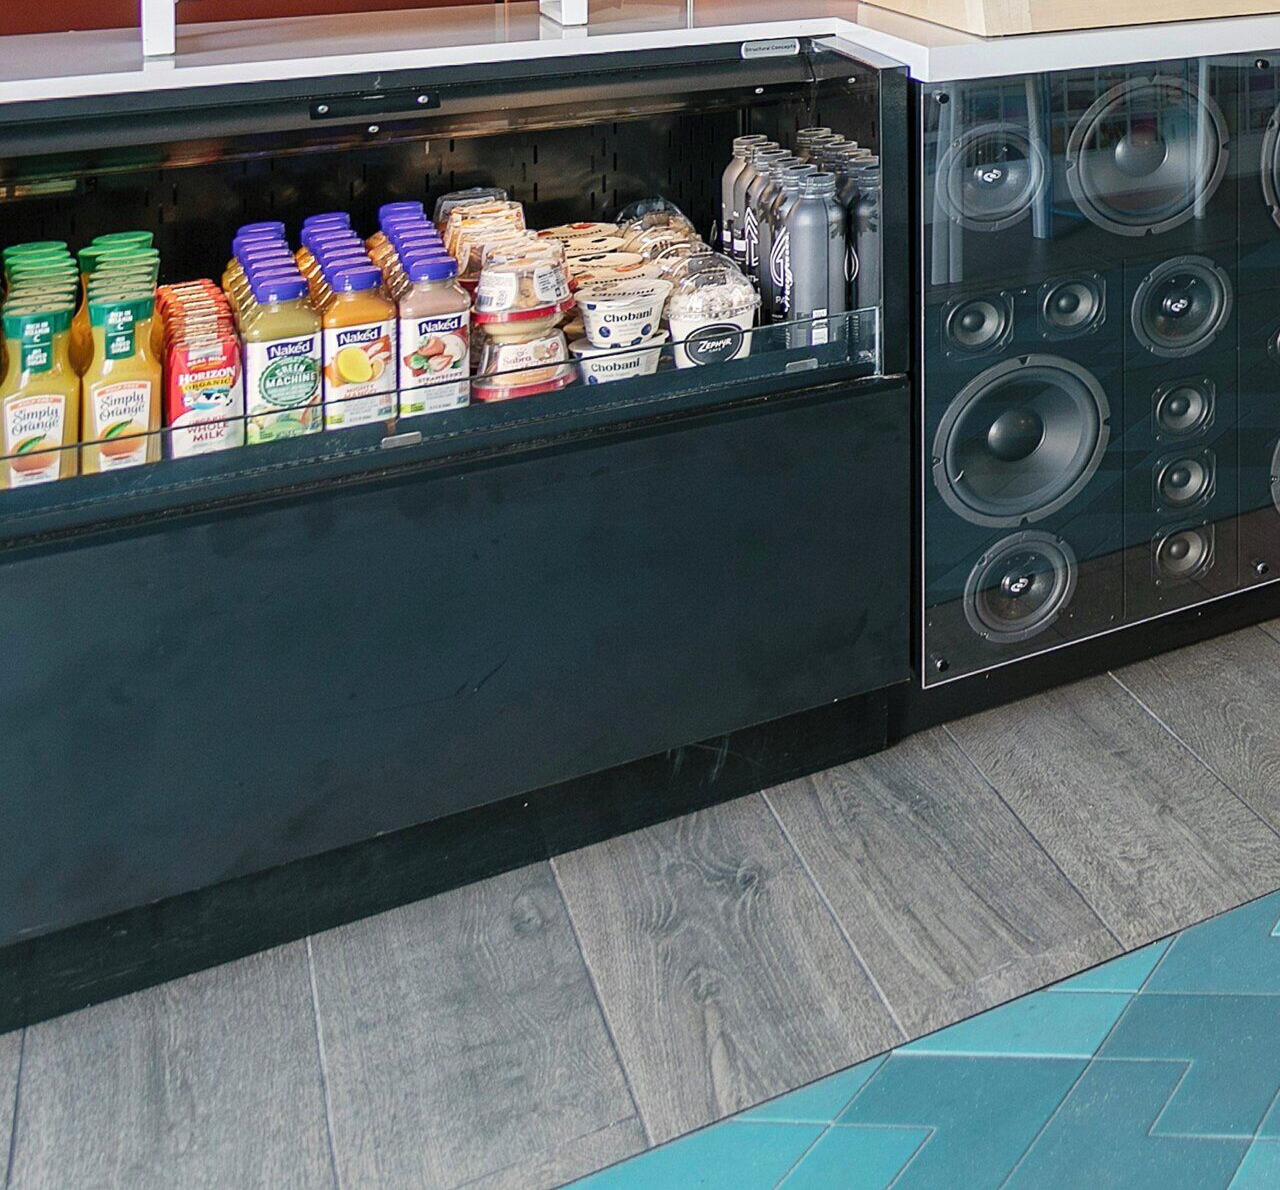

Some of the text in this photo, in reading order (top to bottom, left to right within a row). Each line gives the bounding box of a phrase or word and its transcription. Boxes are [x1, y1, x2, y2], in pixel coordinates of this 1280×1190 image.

[603, 307, 653, 323] Chobani
[697, 338, 732, 353] ZEPHYR
[275, 363, 307, 377] GREEN
[591, 358, 640, 372] Chobani
[178, 366, 236, 386] HORIZON
[265, 372, 317, 389] MACHINE
[184, 379, 231, 392] ORGANIC
[100, 391, 144, 410] Simply
[12, 405, 59, 424] Simply
[99, 403, 145, 422] Orange
[11, 417, 59, 436] Orange
[187, 421, 229, 434] WHOLE
[192, 432, 224, 443] MILK
